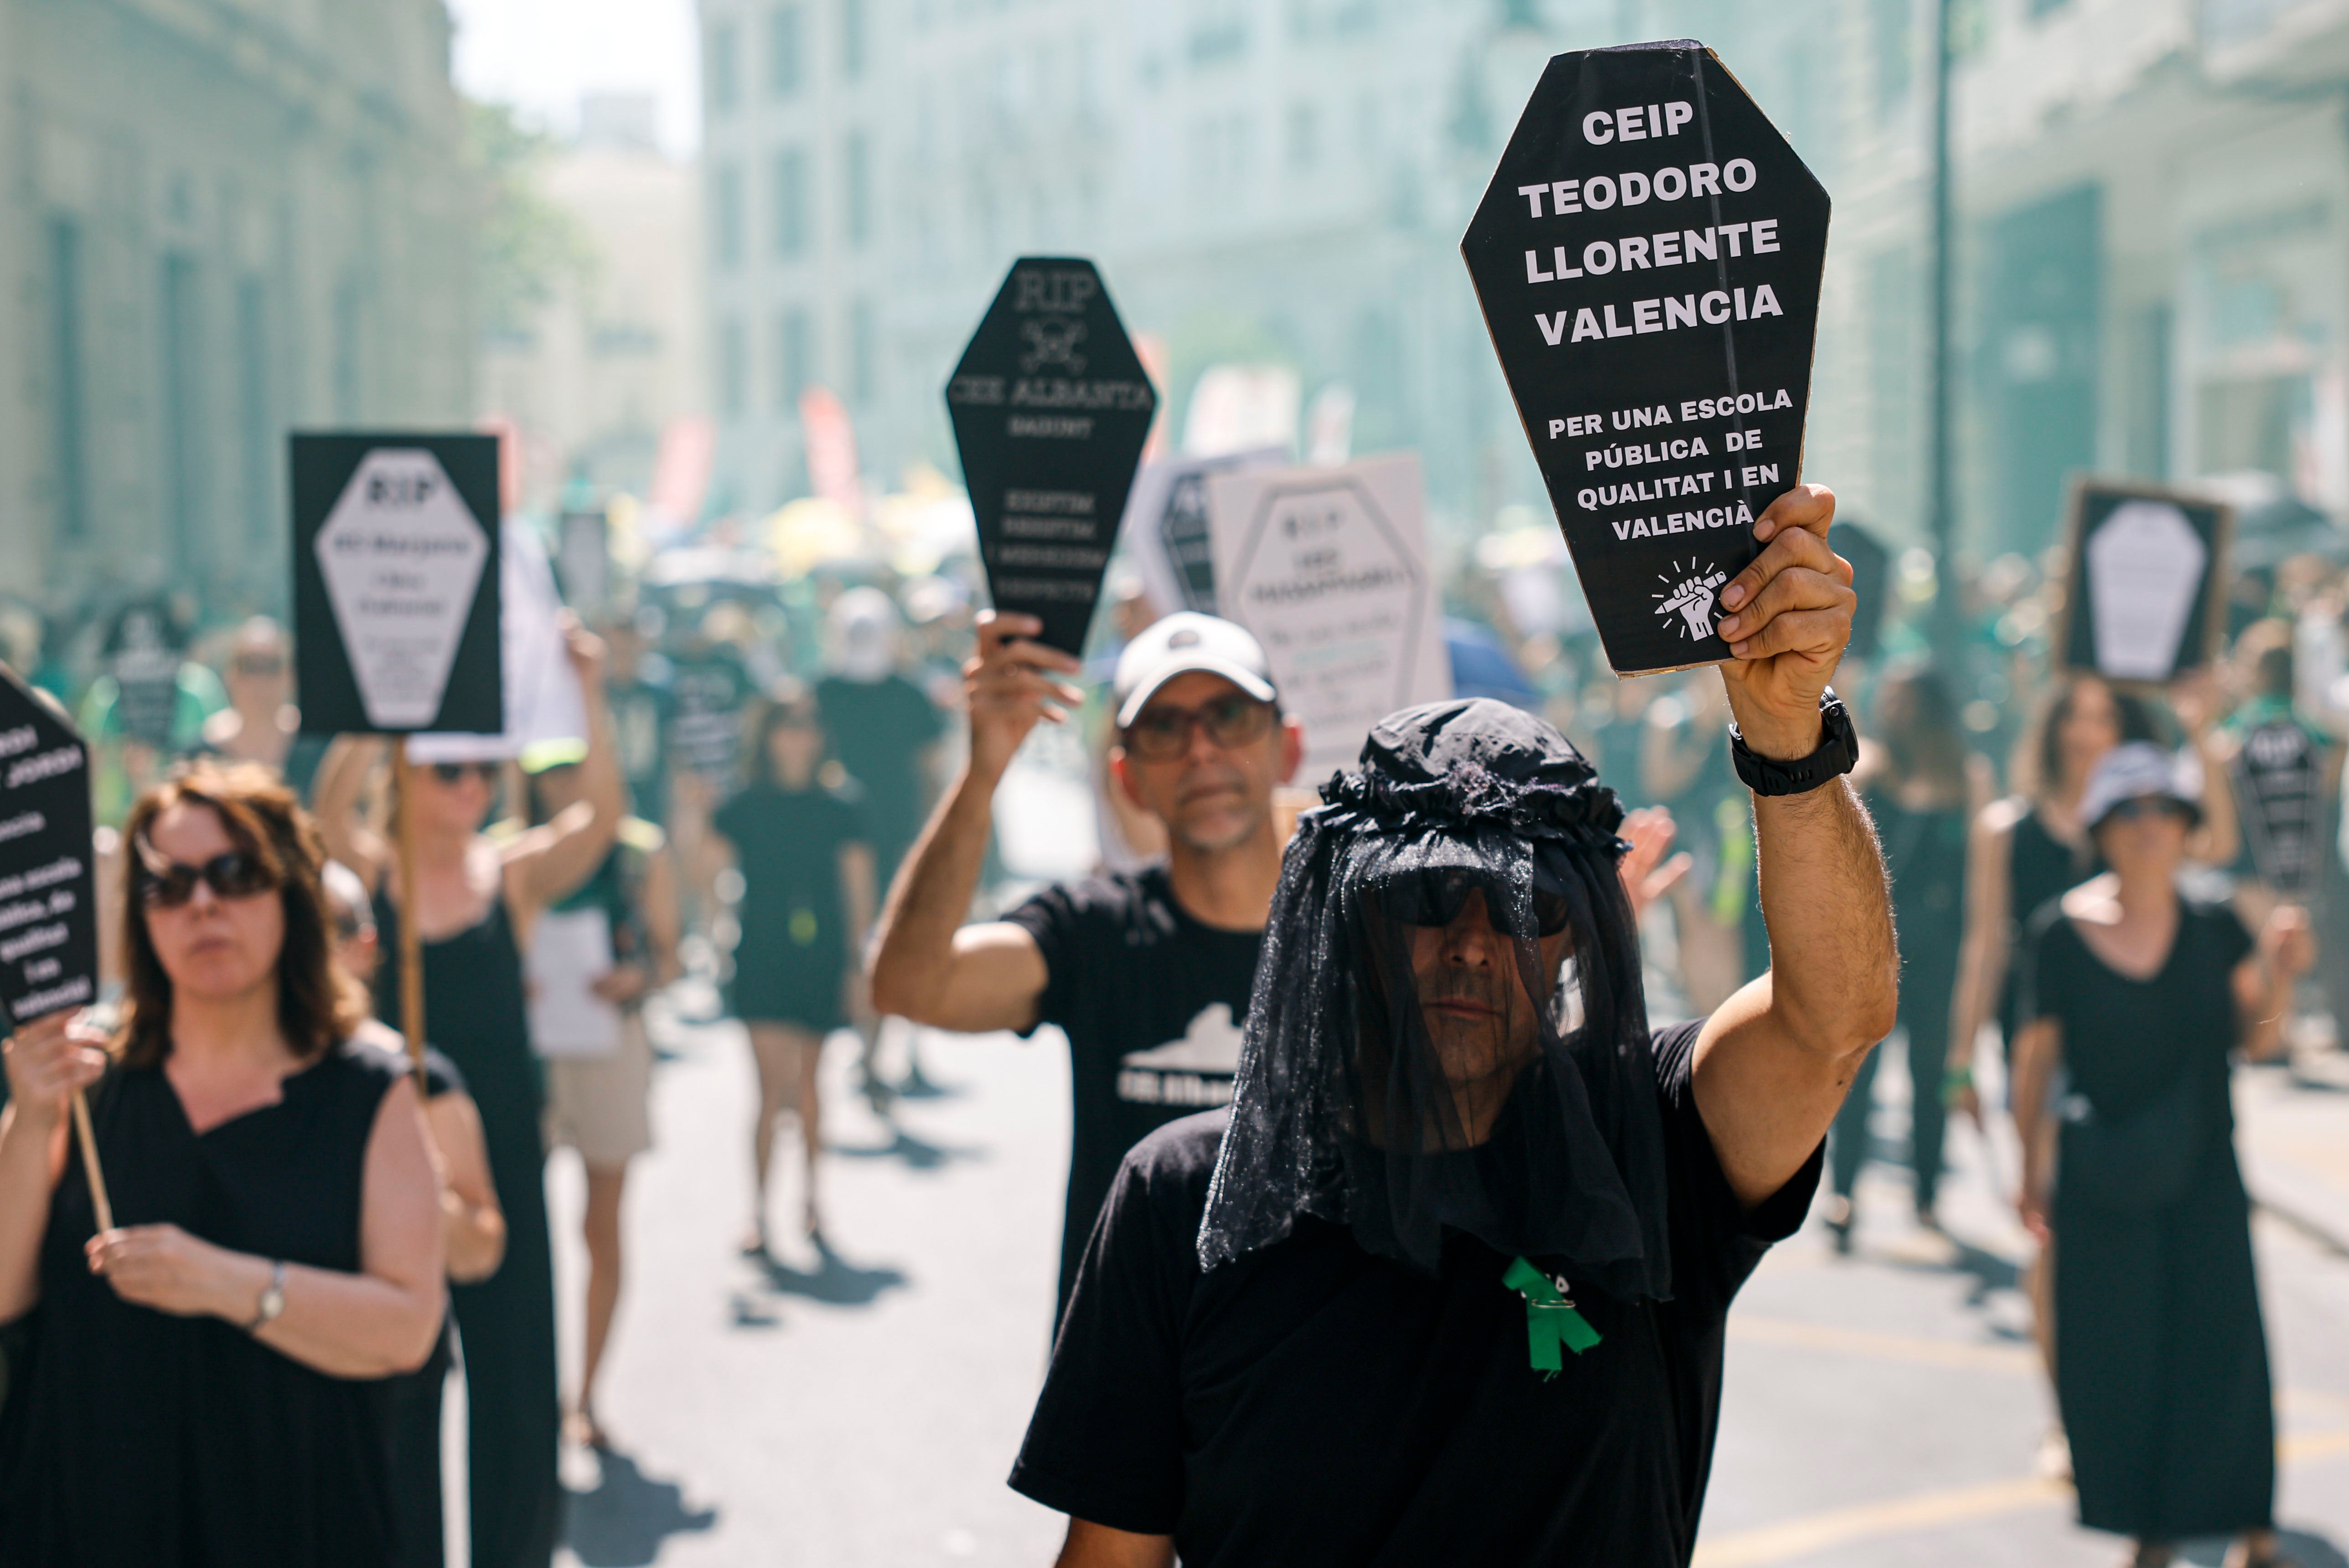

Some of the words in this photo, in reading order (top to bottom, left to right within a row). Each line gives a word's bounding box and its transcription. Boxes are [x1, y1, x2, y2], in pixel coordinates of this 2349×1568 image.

[1583, 102, 1693, 145] CEIP
[1518, 159, 1756, 218] TEODORO
[1526, 219, 1780, 284] LLORENTE
[1014, 273, 1095, 312] RIP
[1535, 284, 1784, 346] VALENCIA
[1549, 414, 1604, 439] PER
[1612, 405, 1673, 430] UNA
[1681, 389, 1793, 422] ESCOLA
[1586, 437, 1709, 471] PÚBLICA
[1726, 429, 1763, 452] DE
[1578, 472, 1714, 511] QUALITAT
[1724, 470, 1732, 489] I
[1742, 464, 1779, 487] EN
[1612, 500, 1754, 541] VALENCIÀ
